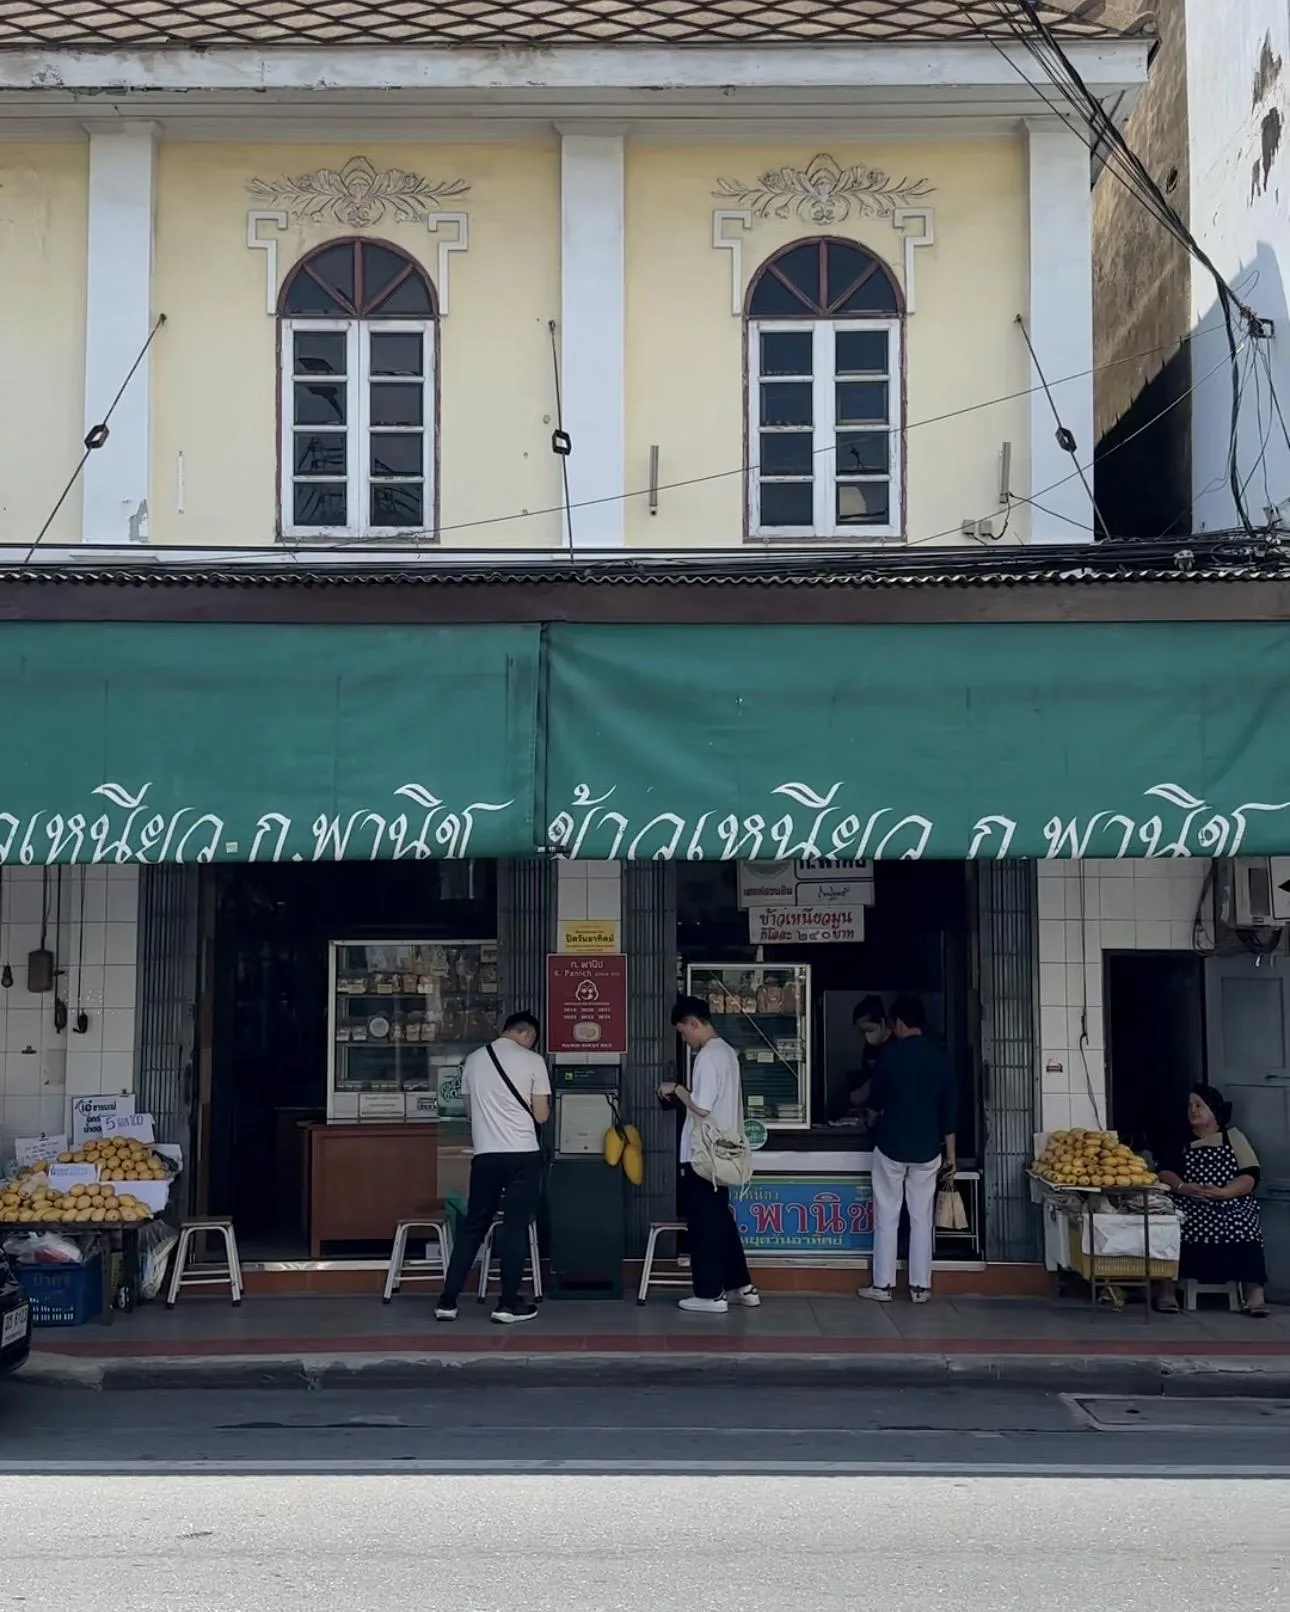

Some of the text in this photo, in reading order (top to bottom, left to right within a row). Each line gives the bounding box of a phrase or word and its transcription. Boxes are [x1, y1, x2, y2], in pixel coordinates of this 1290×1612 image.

[546, 781, 933, 861] ข้าวเหนียว
[759, 908, 853, 929] ข้าวเหนียวมูน
[564, 968, 592, 977] Panich
